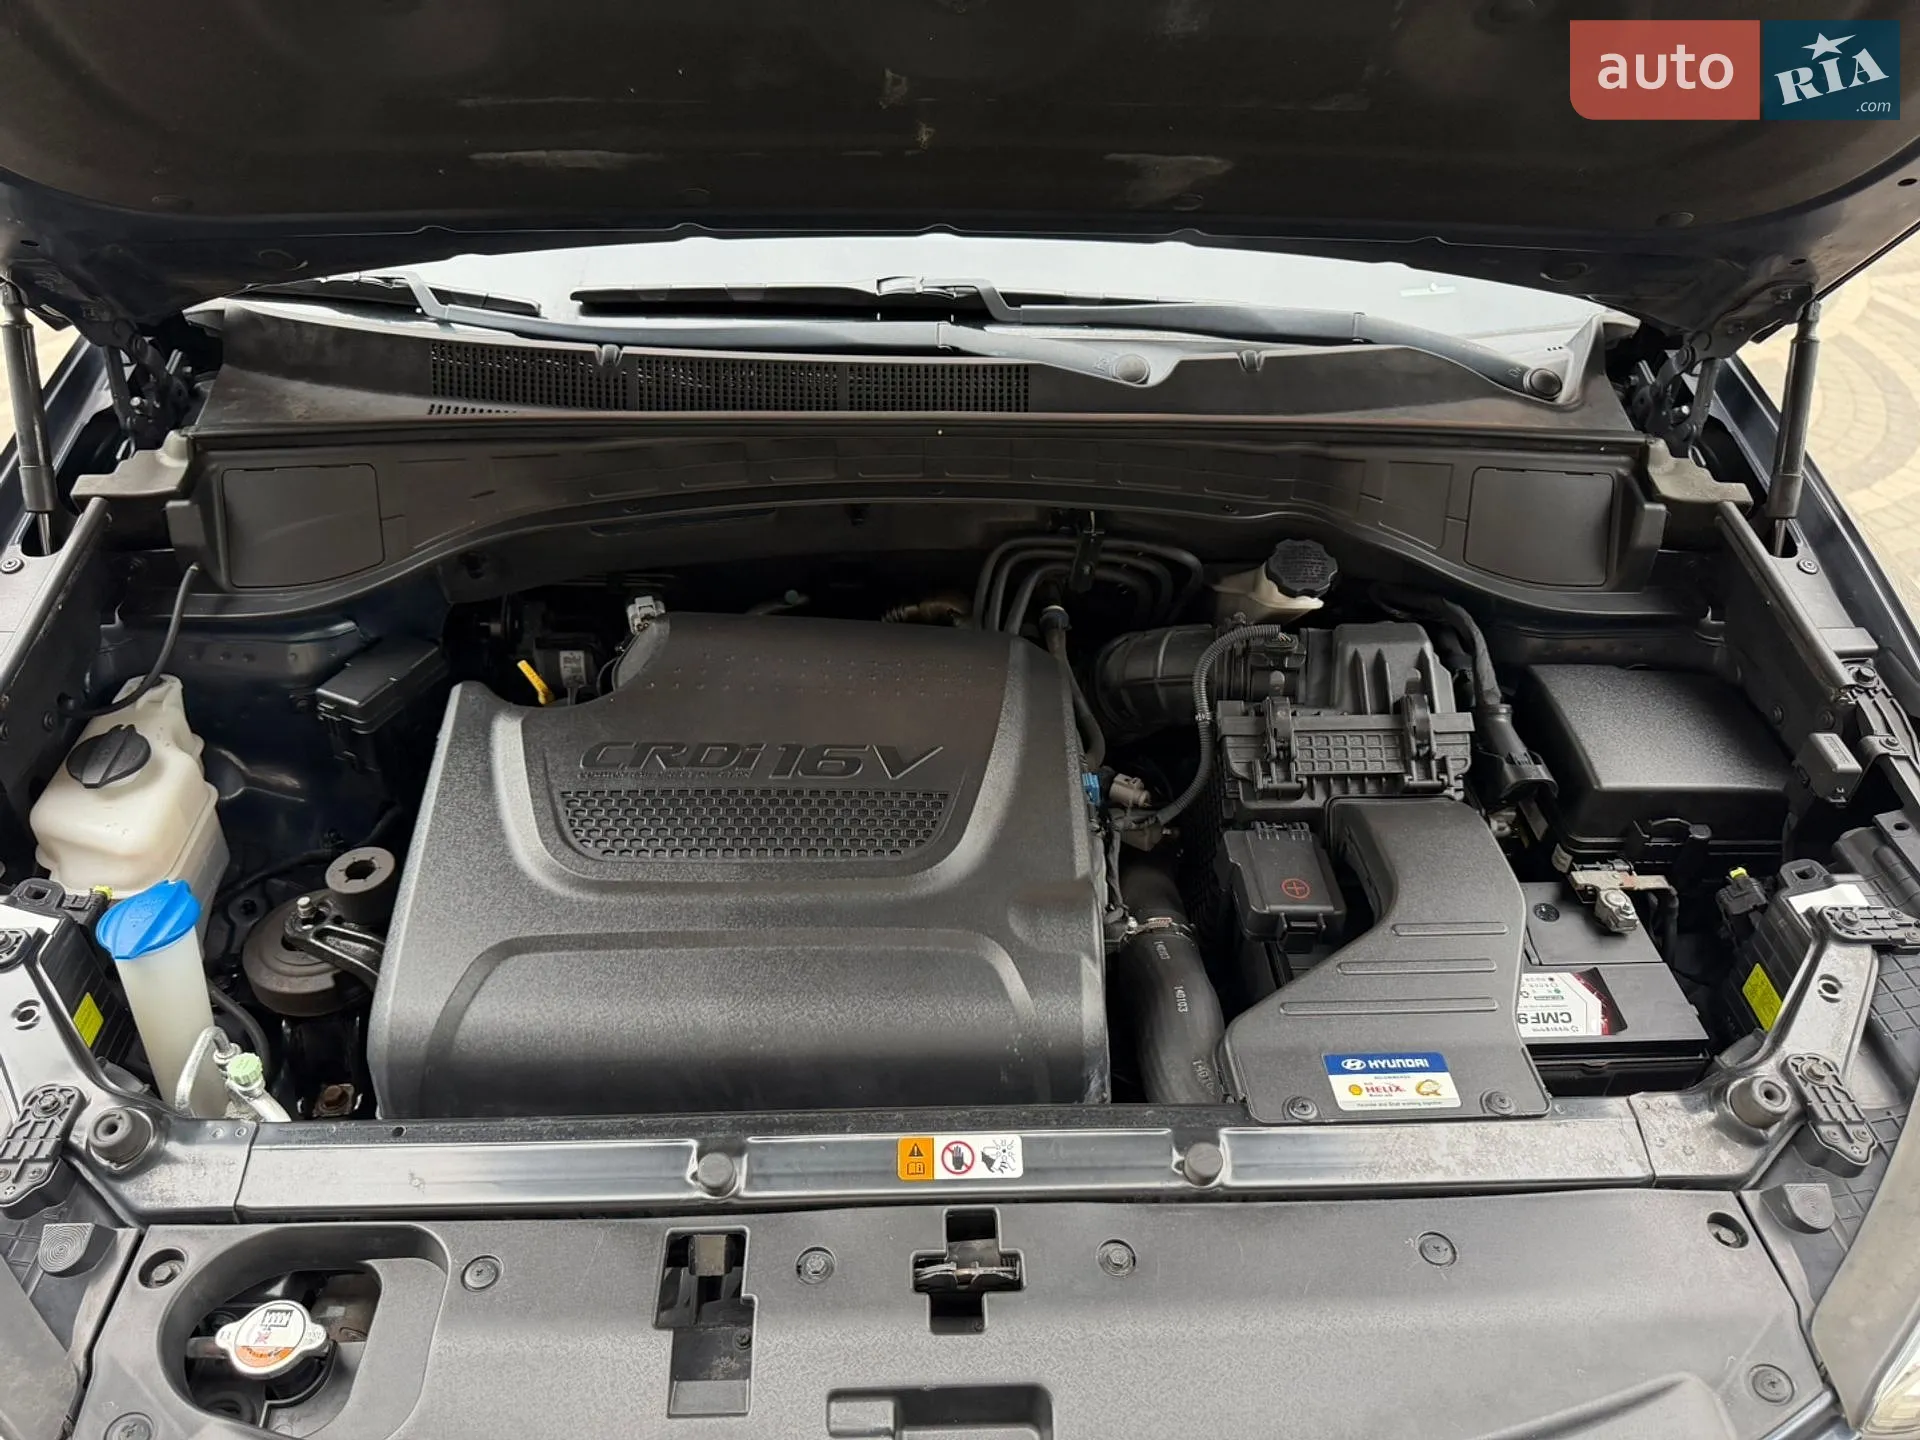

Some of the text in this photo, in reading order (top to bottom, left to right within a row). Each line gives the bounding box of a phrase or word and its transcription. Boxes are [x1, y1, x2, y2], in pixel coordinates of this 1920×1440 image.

[579, 741, 944, 780] CRDi 16V
[1367, 1058, 1429, 1068] HYUNDAI
[1365, 1085, 1405, 1093] HELIX
